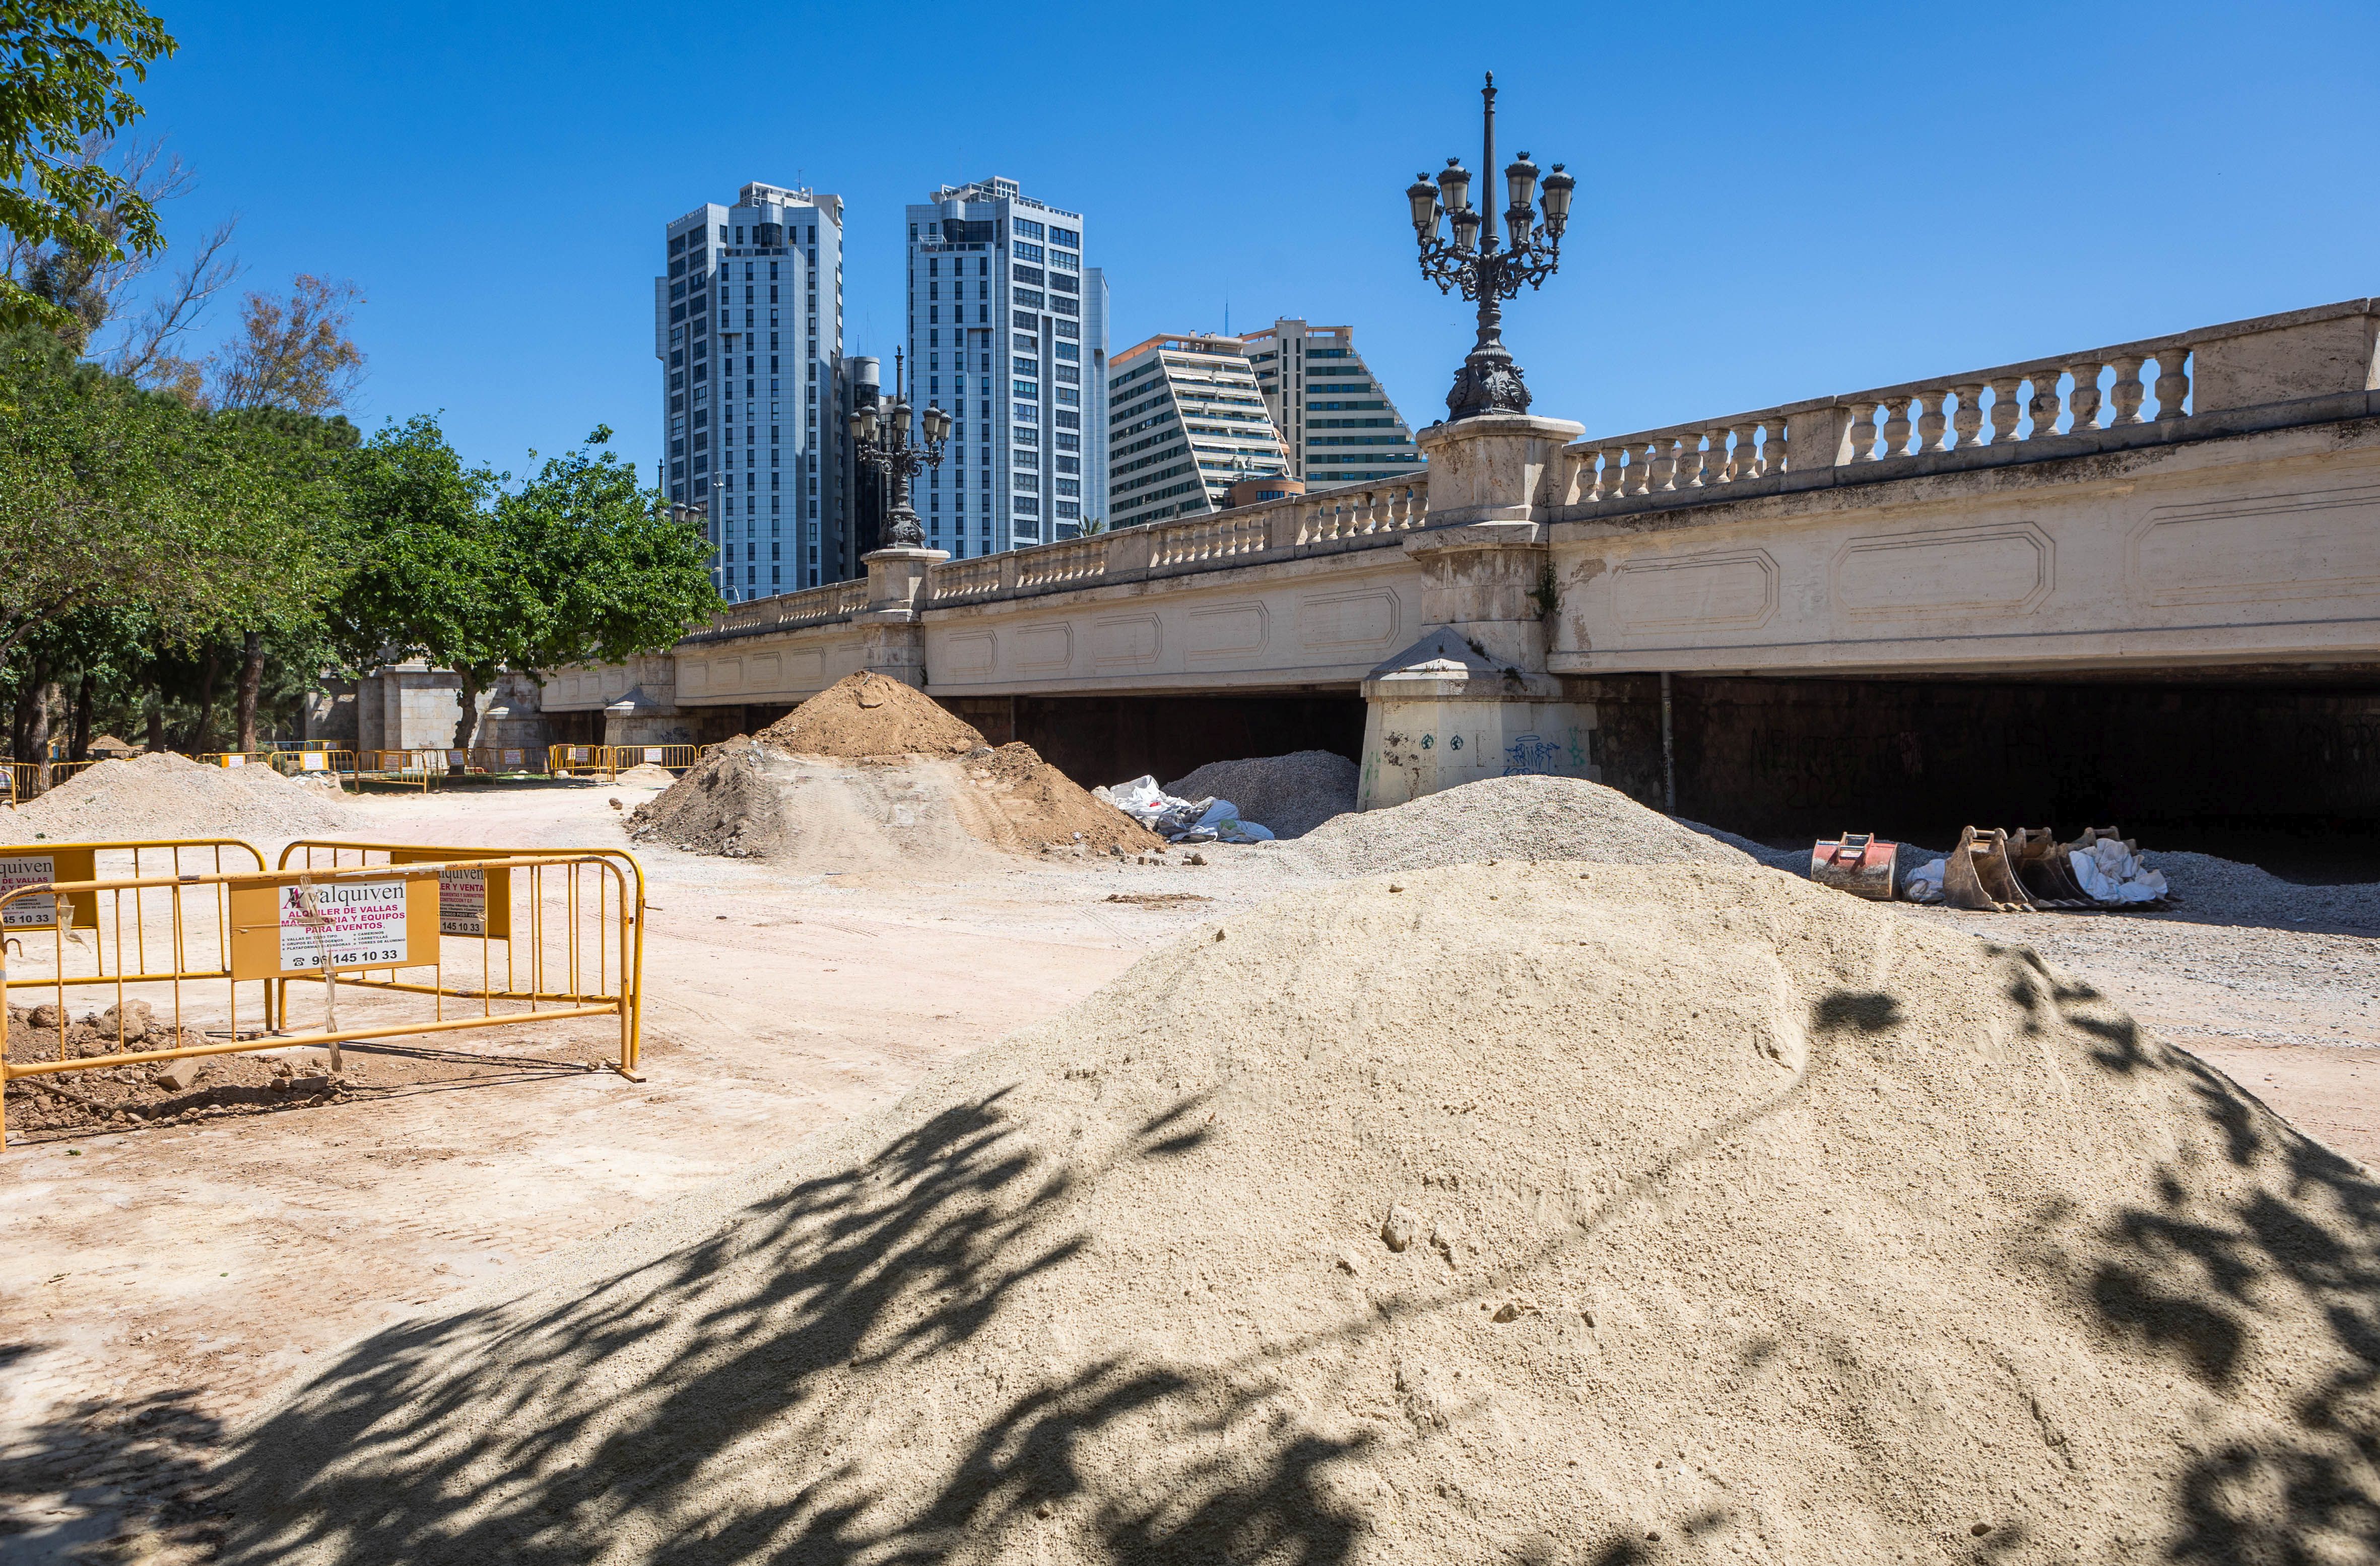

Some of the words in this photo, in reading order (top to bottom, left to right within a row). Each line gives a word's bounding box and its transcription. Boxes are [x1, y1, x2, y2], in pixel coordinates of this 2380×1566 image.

[360, 904, 398, 912] VALLAS
[361, 912, 405, 922] EQUIPOS
[442, 922, 456, 930] 145
[459, 923, 468, 931] 10
[333, 953, 357, 963] 145
[362, 951, 377, 961] 10
[382, 950, 397, 959] 33
